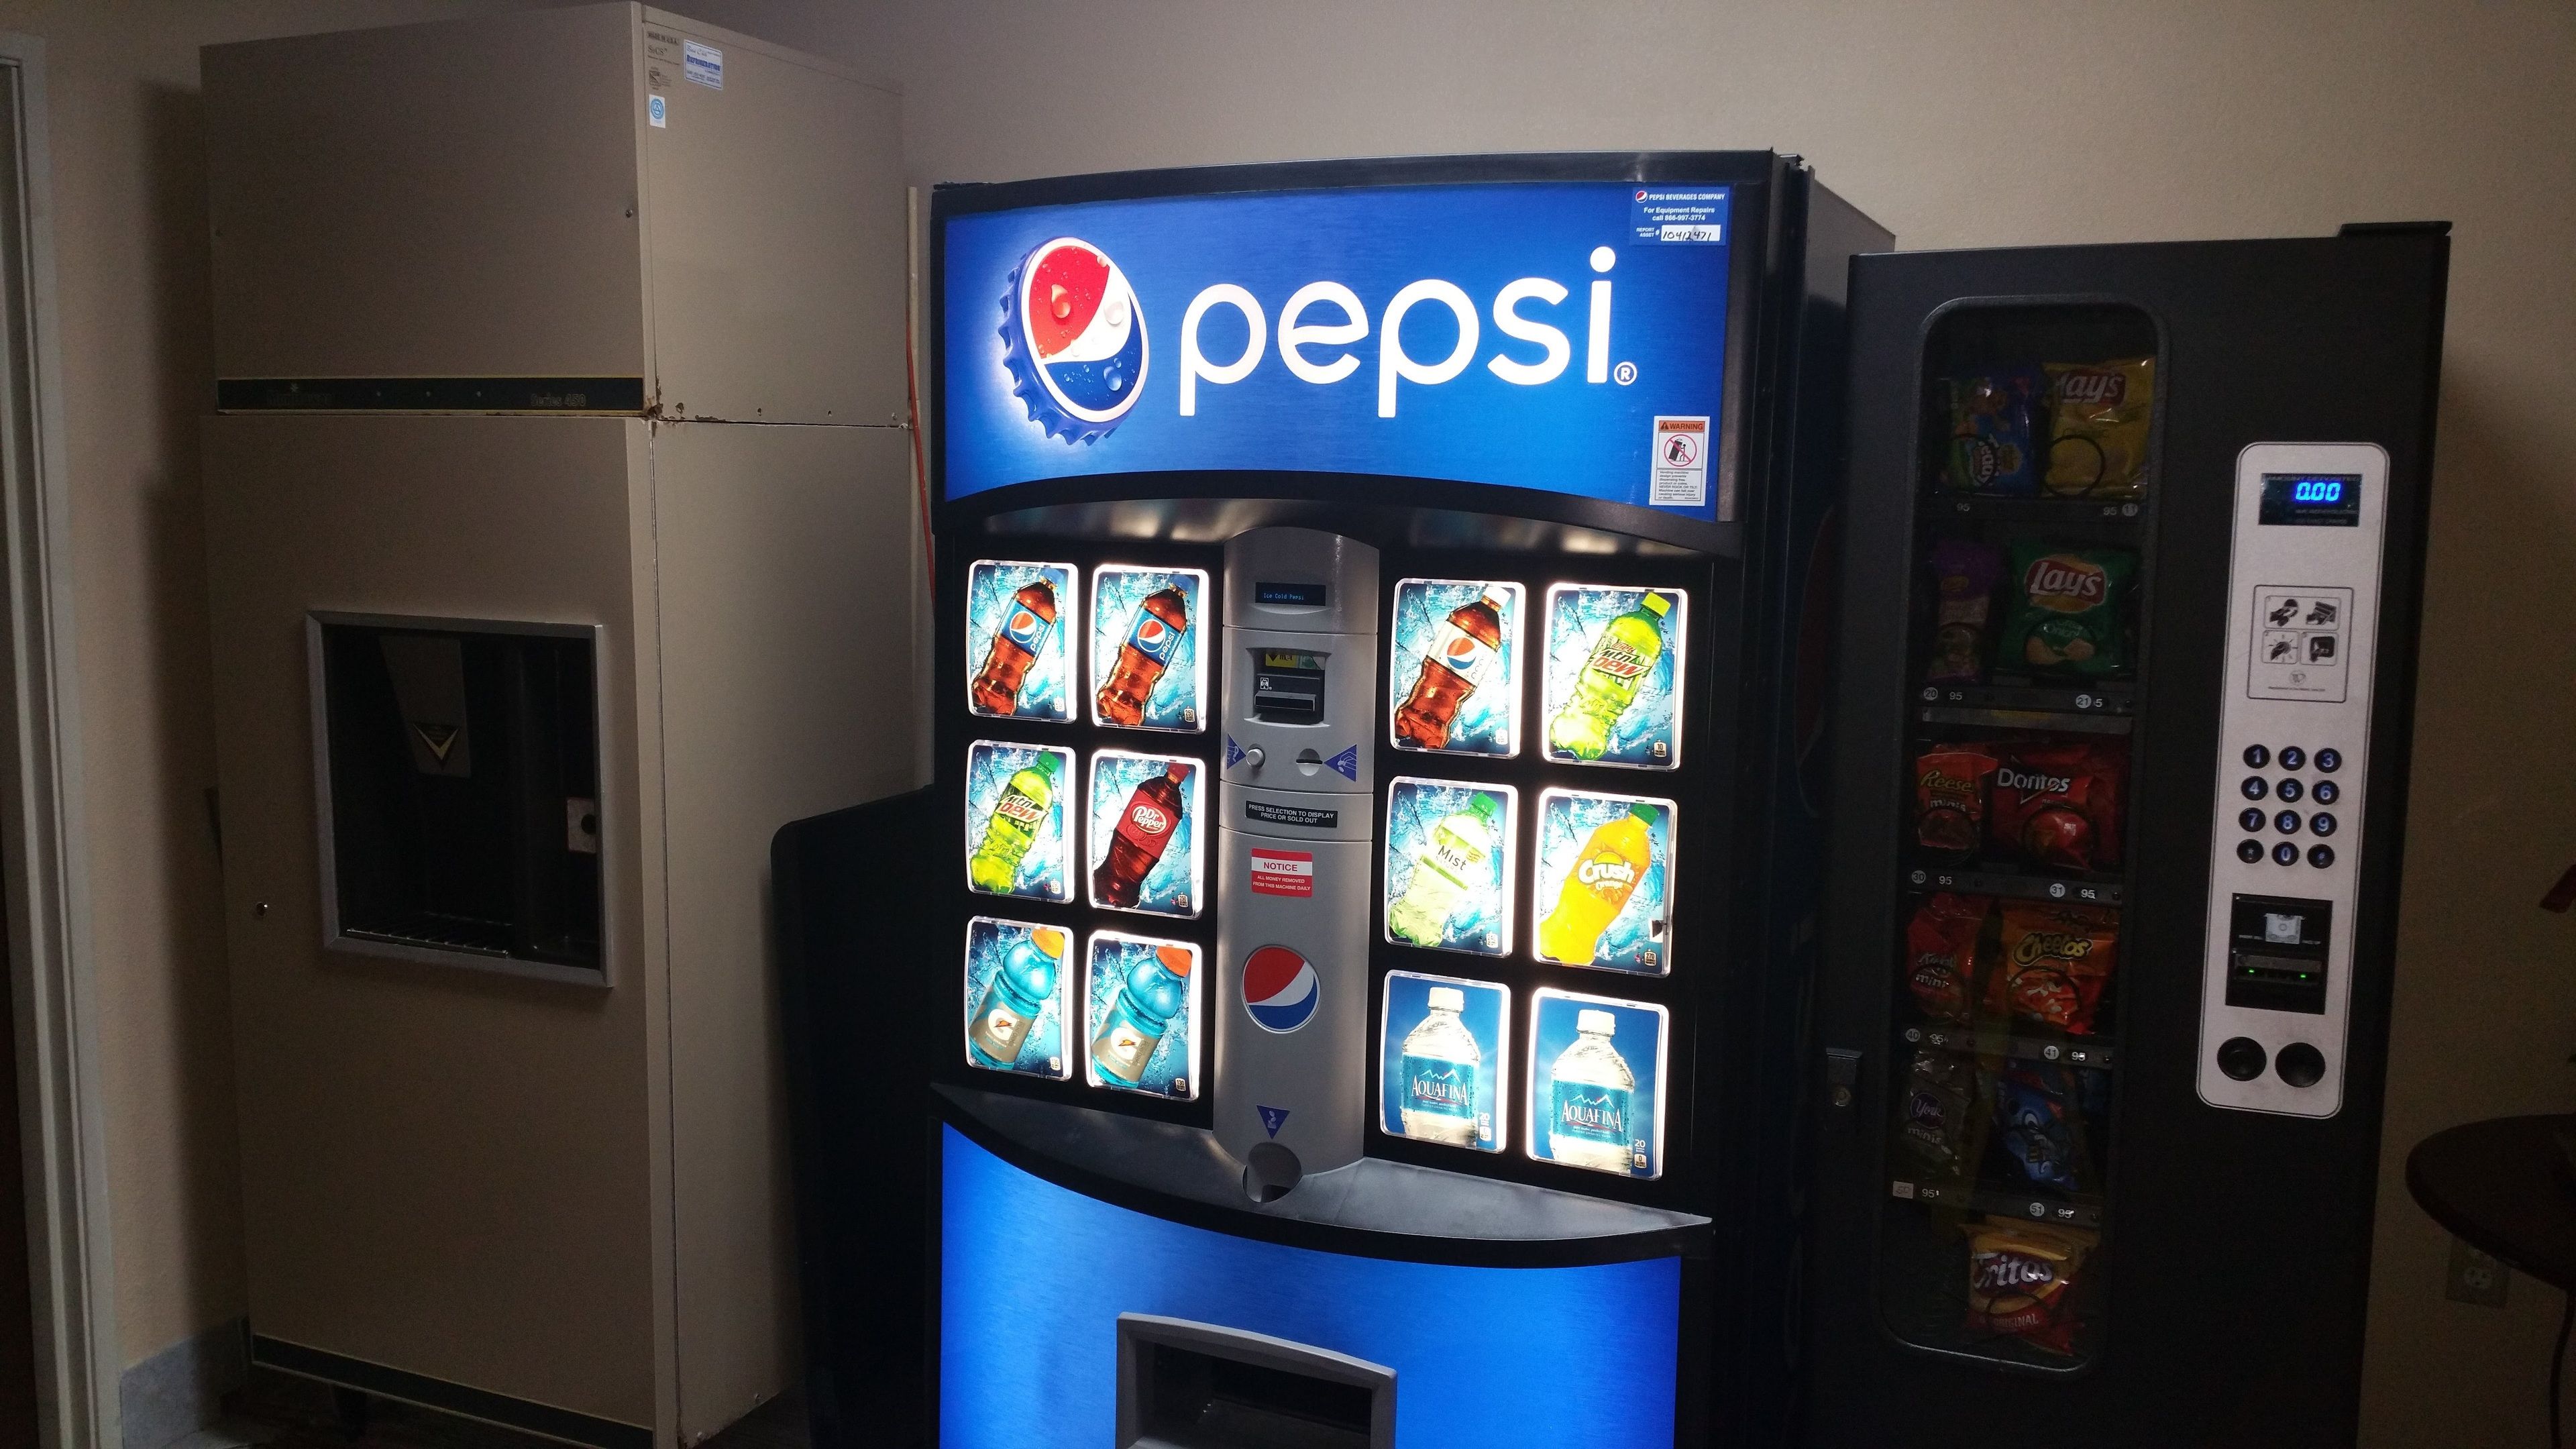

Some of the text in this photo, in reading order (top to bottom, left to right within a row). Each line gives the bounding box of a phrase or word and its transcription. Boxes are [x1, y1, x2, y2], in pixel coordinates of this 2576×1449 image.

[1180, 246, 1615, 418] pepsi
[1029, 623, 1045, 652] pepsi
[1159, 631, 1175, 661] pepsi
[1949, 692, 1963, 701] 95
[2254, 749, 2334, 767] 1 2 3
[1996, 767, 2071, 792] Doritos
[2249, 780, 2330, 800] 4 5 6
[1133, 806, 1165, 828] Pepper
[1145, 808, 1160, 820] Dr
[1248, 804, 1265, 812] PRESS
[1266, 806, 1298, 816] SELECTION
[2248, 813, 2328, 832] 7 8 9
[2281, 847, 2290, 861] 0
[1263, 861, 1298, 872] NOTICE
[1578, 859, 1635, 885] Crush
[1939, 875, 1953, 885] 95
[2081, 889, 2096, 900] 95
[2014, 934, 2091, 965] Cheetos
[1411, 1075, 1468, 1106] AQUAFINA
[1560, 1099, 1622, 1132] AQUAFINA
[1634, 1138, 1646, 1148] 20
[1922, 1188, 1935, 1198] 95
